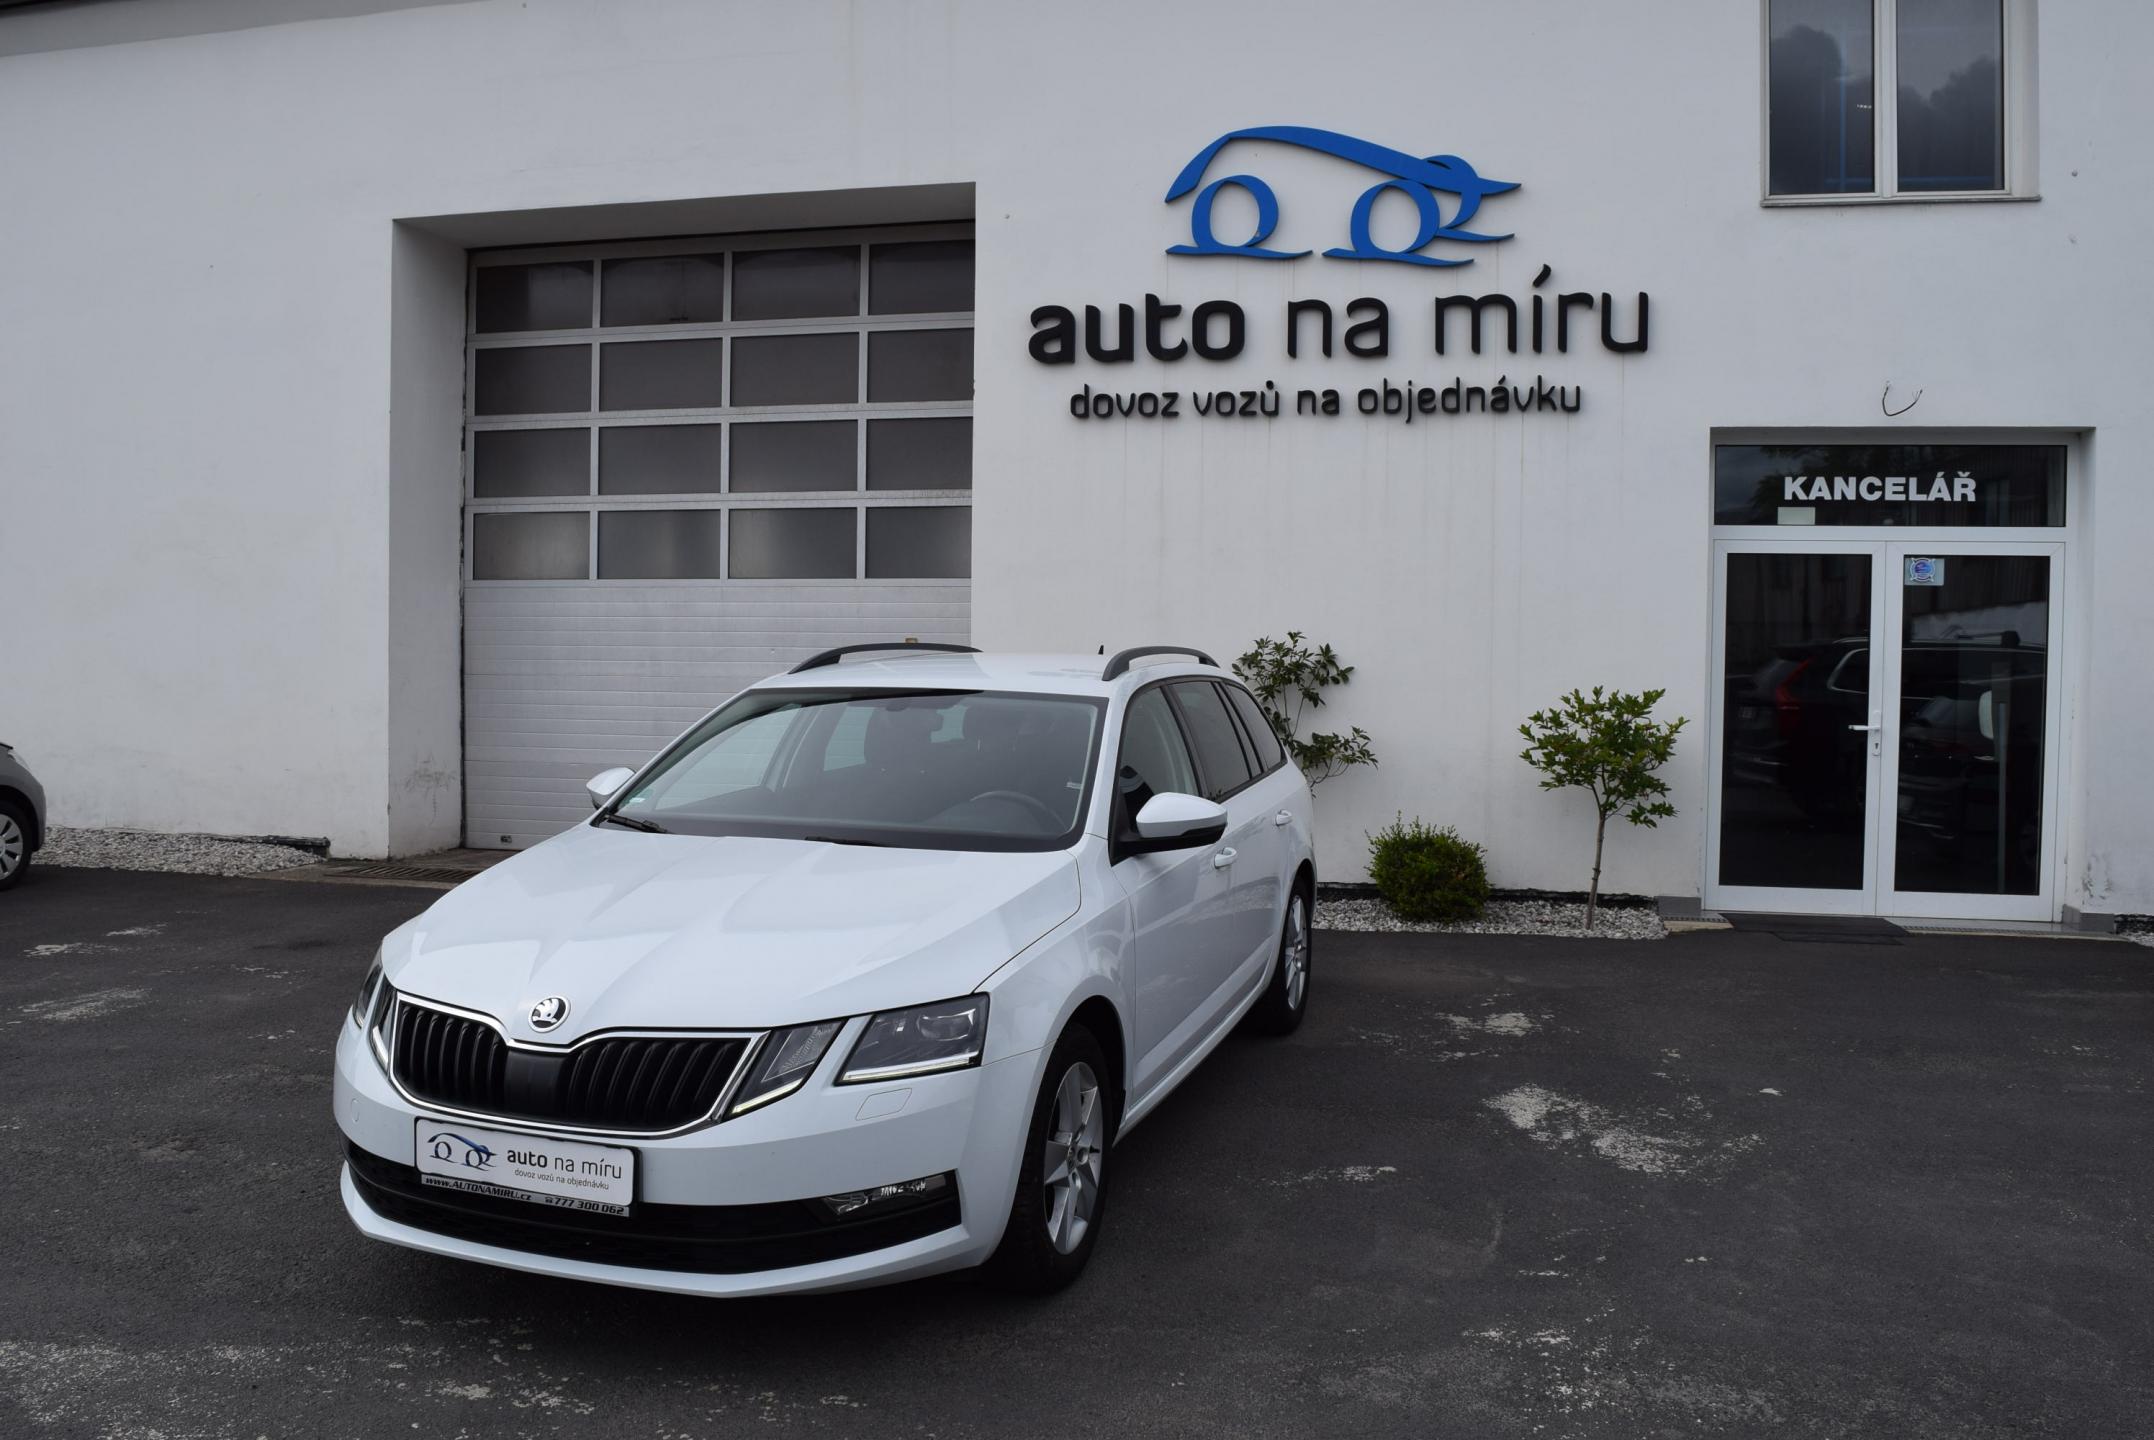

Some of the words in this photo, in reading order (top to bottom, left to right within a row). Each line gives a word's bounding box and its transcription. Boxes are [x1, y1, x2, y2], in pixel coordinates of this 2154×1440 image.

[1029, 292, 1246, 365] auto
[1287, 296, 1389, 359] na
[1435, 263, 1649, 355] míru
[1070, 383, 1180, 419] dovoz
[1193, 380, 1280, 418] vozů
[1297, 389, 1340, 416] na
[1357, 374, 1581, 425] objednávku
[1784, 471, 1977, 502] KANCELÁŘ
[507, 1149, 548, 1168] auto
[554, 1157, 575, 1173] na
[581, 1158, 622, 1179] míru
[514, 1168, 536, 1179] dovoz
[537, 1173, 554, 1182] vozů
[555, 1176, 566, 1184] na
[566, 1176, 610, 1190] objednávku
[554, 1196, 576, 1208] 777
[577, 1201, 600, 1211] 300
[601, 1204, 625, 1215] 062
